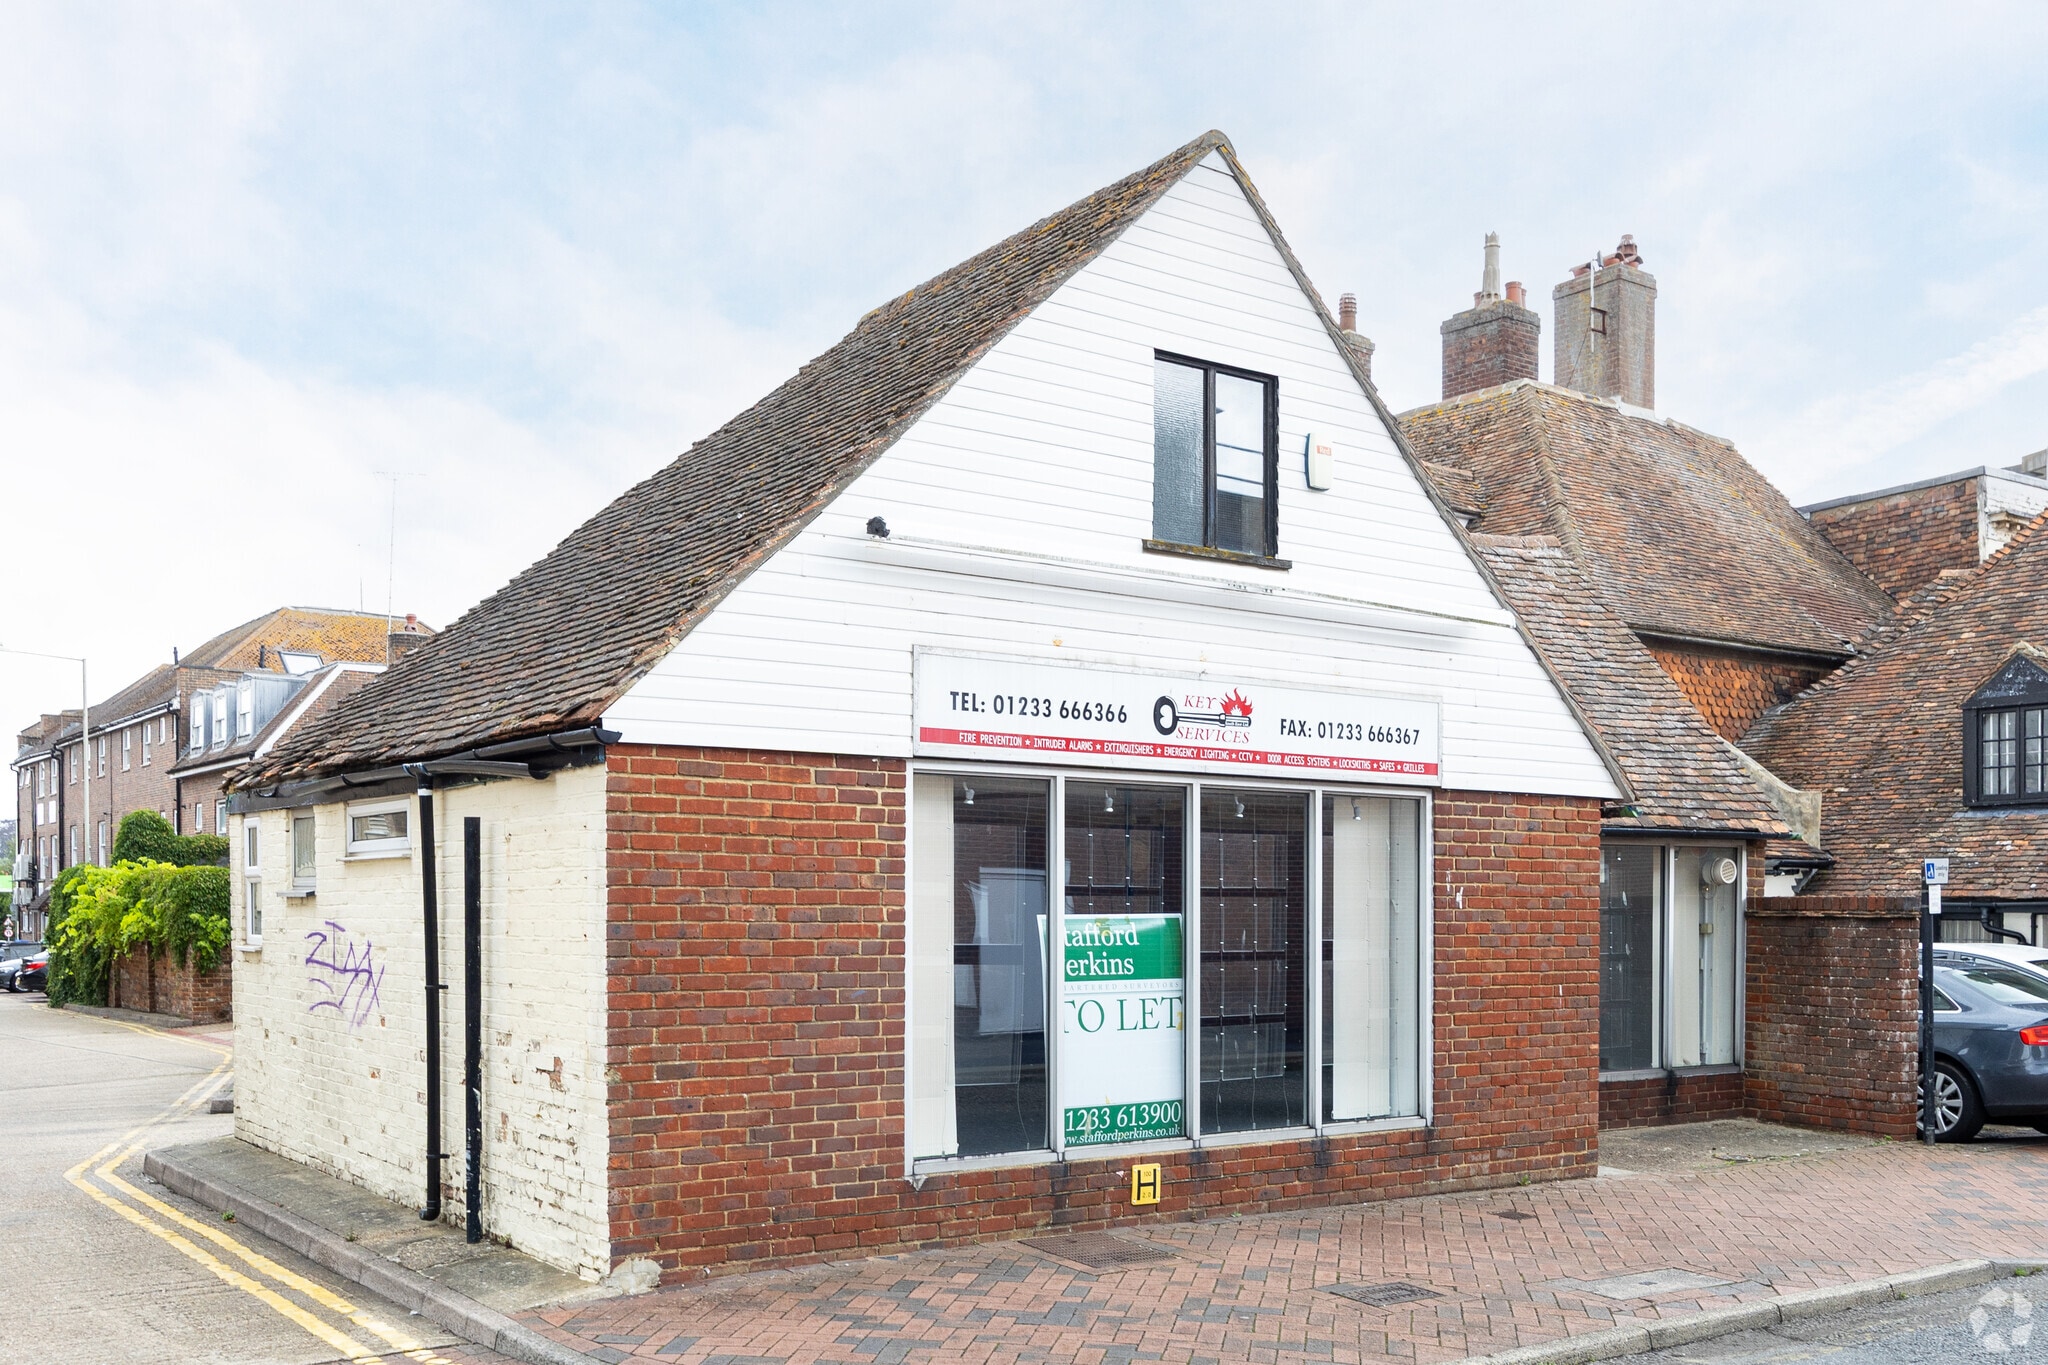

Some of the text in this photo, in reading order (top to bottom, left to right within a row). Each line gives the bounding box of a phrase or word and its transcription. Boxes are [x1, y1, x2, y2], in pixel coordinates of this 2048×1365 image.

[950, 690, 1127, 723] TEL: 01233 666366
[1184, 695, 1216, 709] KEY
[1176, 726, 1250, 744] SERVICES
[1280, 718, 1419, 745] FAX: 01233 666367
[959, 732, 1425, 773] FIRE PREVENTION INTRUDER ALARMS EXTINGUISHERS EMERGENCY LIGHTING CCTV DOOR ACCESS SYSTEMS LOCKSMITHS SAFES GRILLES
[1063, 922, 1140, 947] tafford
[1065, 951, 1135, 977] erkins
[1063, 981, 1180, 992] ARTERED SURVEYORS
[1116, 996, 1183, 1031] LET
[1065, 1101, 1182, 1132] 1233 613900
[1136, 1168, 1157, 1201] H
